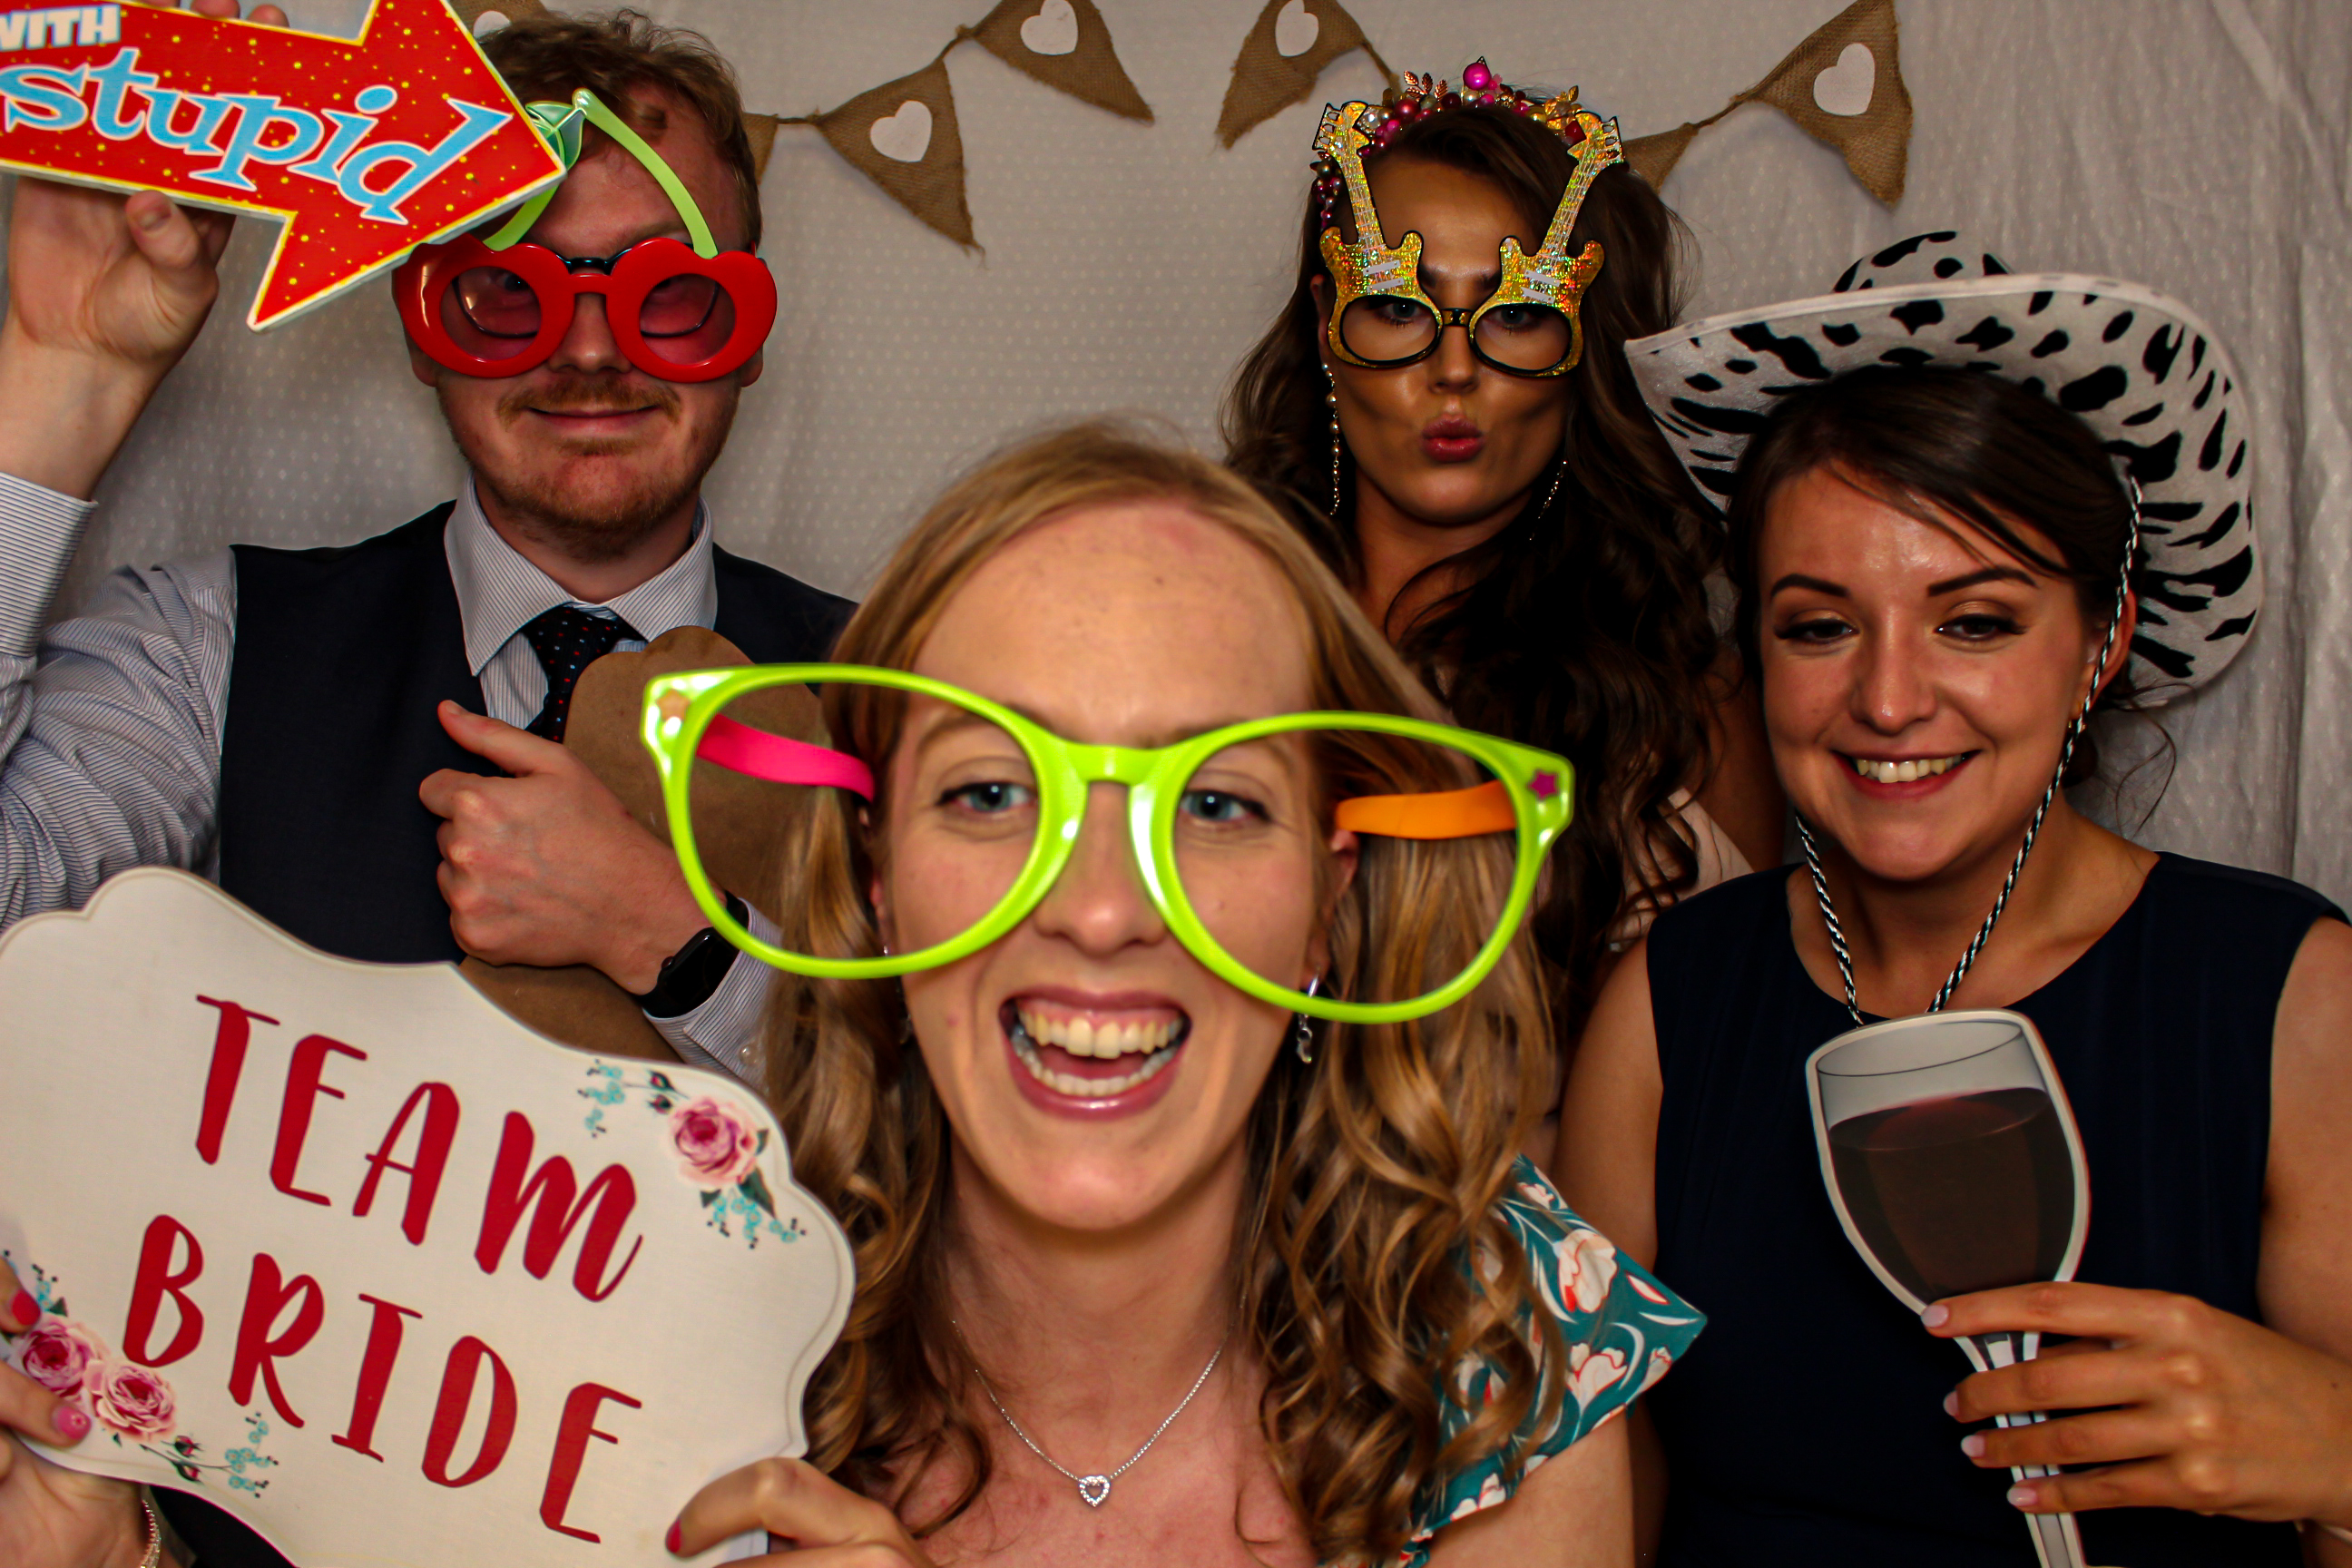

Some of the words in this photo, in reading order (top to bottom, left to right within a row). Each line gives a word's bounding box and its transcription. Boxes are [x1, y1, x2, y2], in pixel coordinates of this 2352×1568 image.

[0, 46, 514, 225] stupid
[195, 994, 643, 1303] TEAM
[122, 1213, 643, 1544] BRIDE
